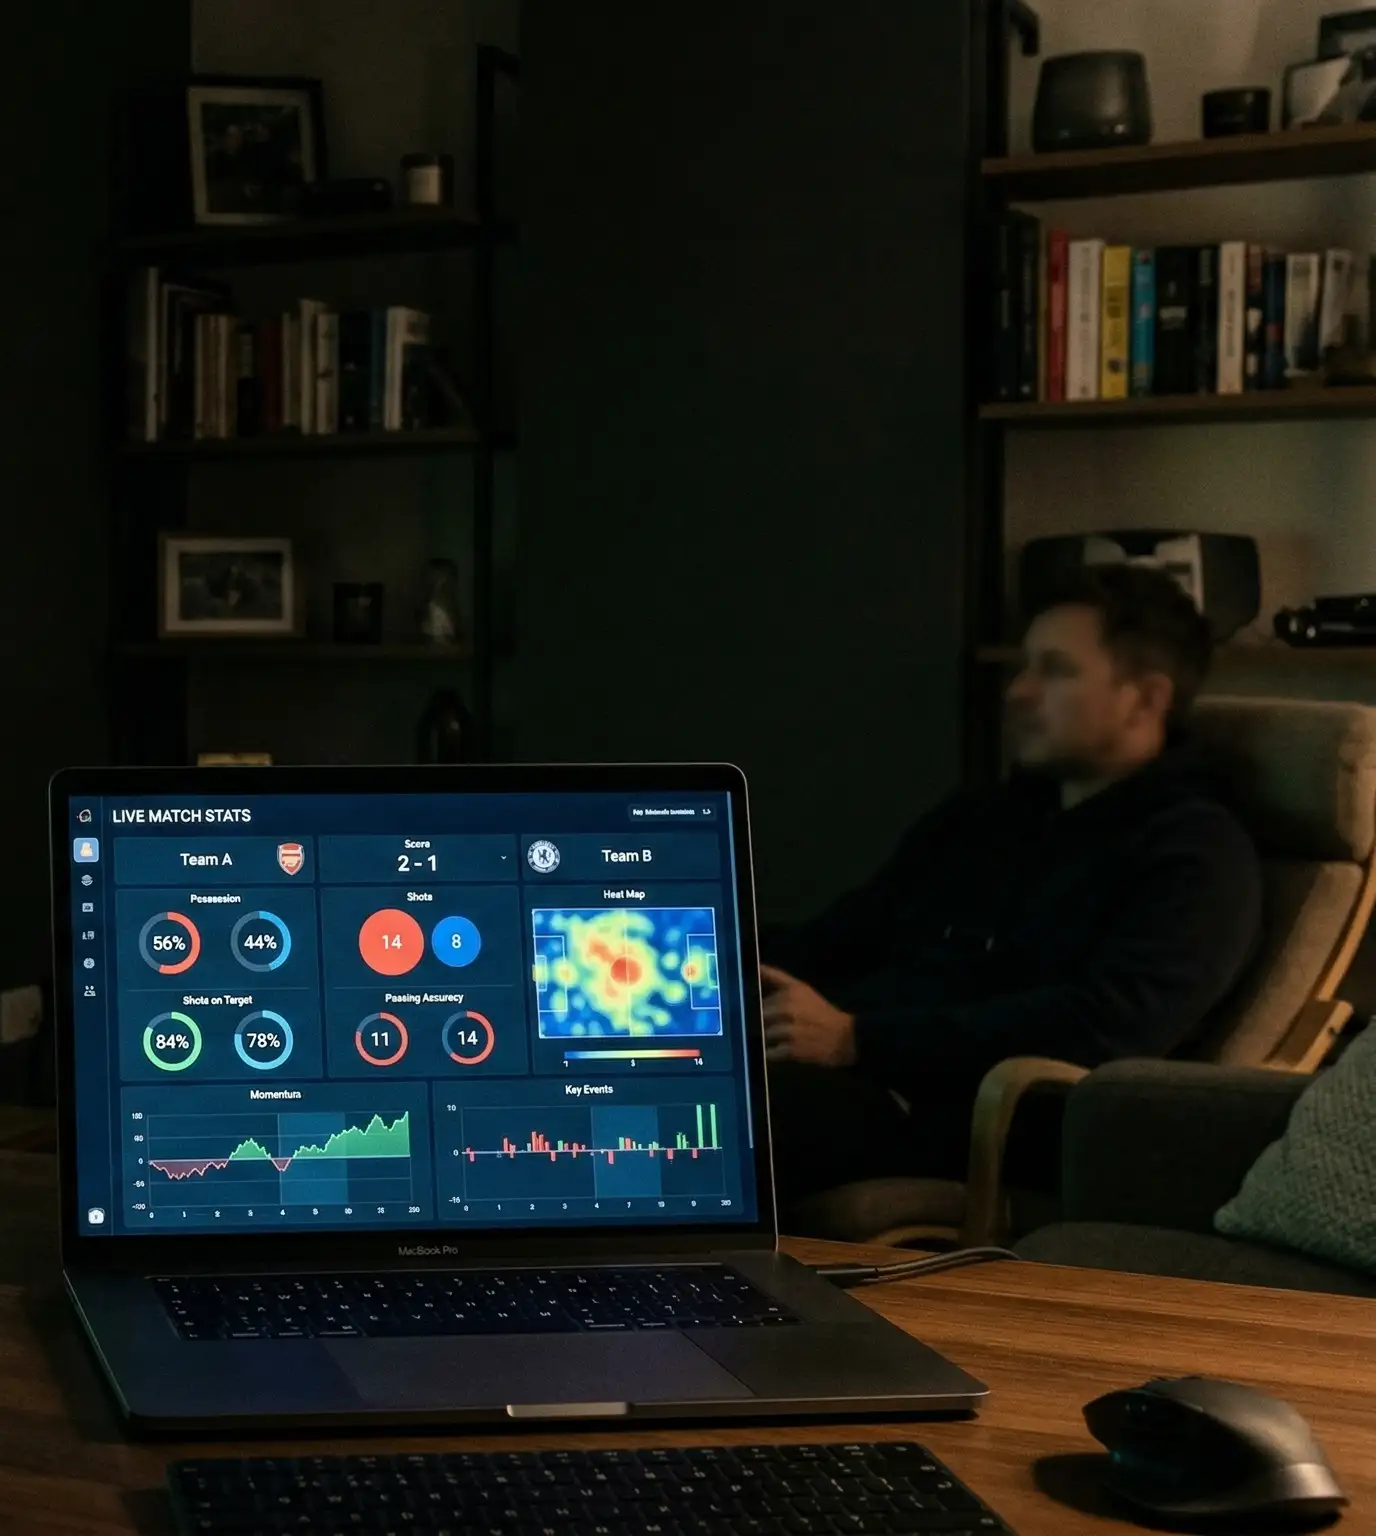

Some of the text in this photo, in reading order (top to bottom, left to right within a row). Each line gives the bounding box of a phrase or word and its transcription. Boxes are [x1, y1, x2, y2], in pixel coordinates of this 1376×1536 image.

[113, 809, 251, 822] LIVE MATCH STATS
[180, 853, 232, 865] Team A
[602, 850, 652, 862] Team B
[398, 855, 409, 871] 2
[428, 855, 436, 871] 1
[604, 889, 645, 900] Heat Map
[154, 936, 185, 950] 56%
[244, 935, 277, 949] 44%
[382, 935, 402, 949] 14
[452, 934, 461, 948] 8
[210, 997, 223, 1005] on
[156, 1034, 189, 1049] 84%
[247, 1033, 280, 1048] 78%
[372, 1032, 388, 1046] 11
[458, 1031, 478, 1045] 14
[566, 1084, 613, 1096] Key Events
[452, 1149, 459, 1157] 0
[137, 1157, 144, 1165] 0
[399, 1245, 458, 1255] MacBook Pro
